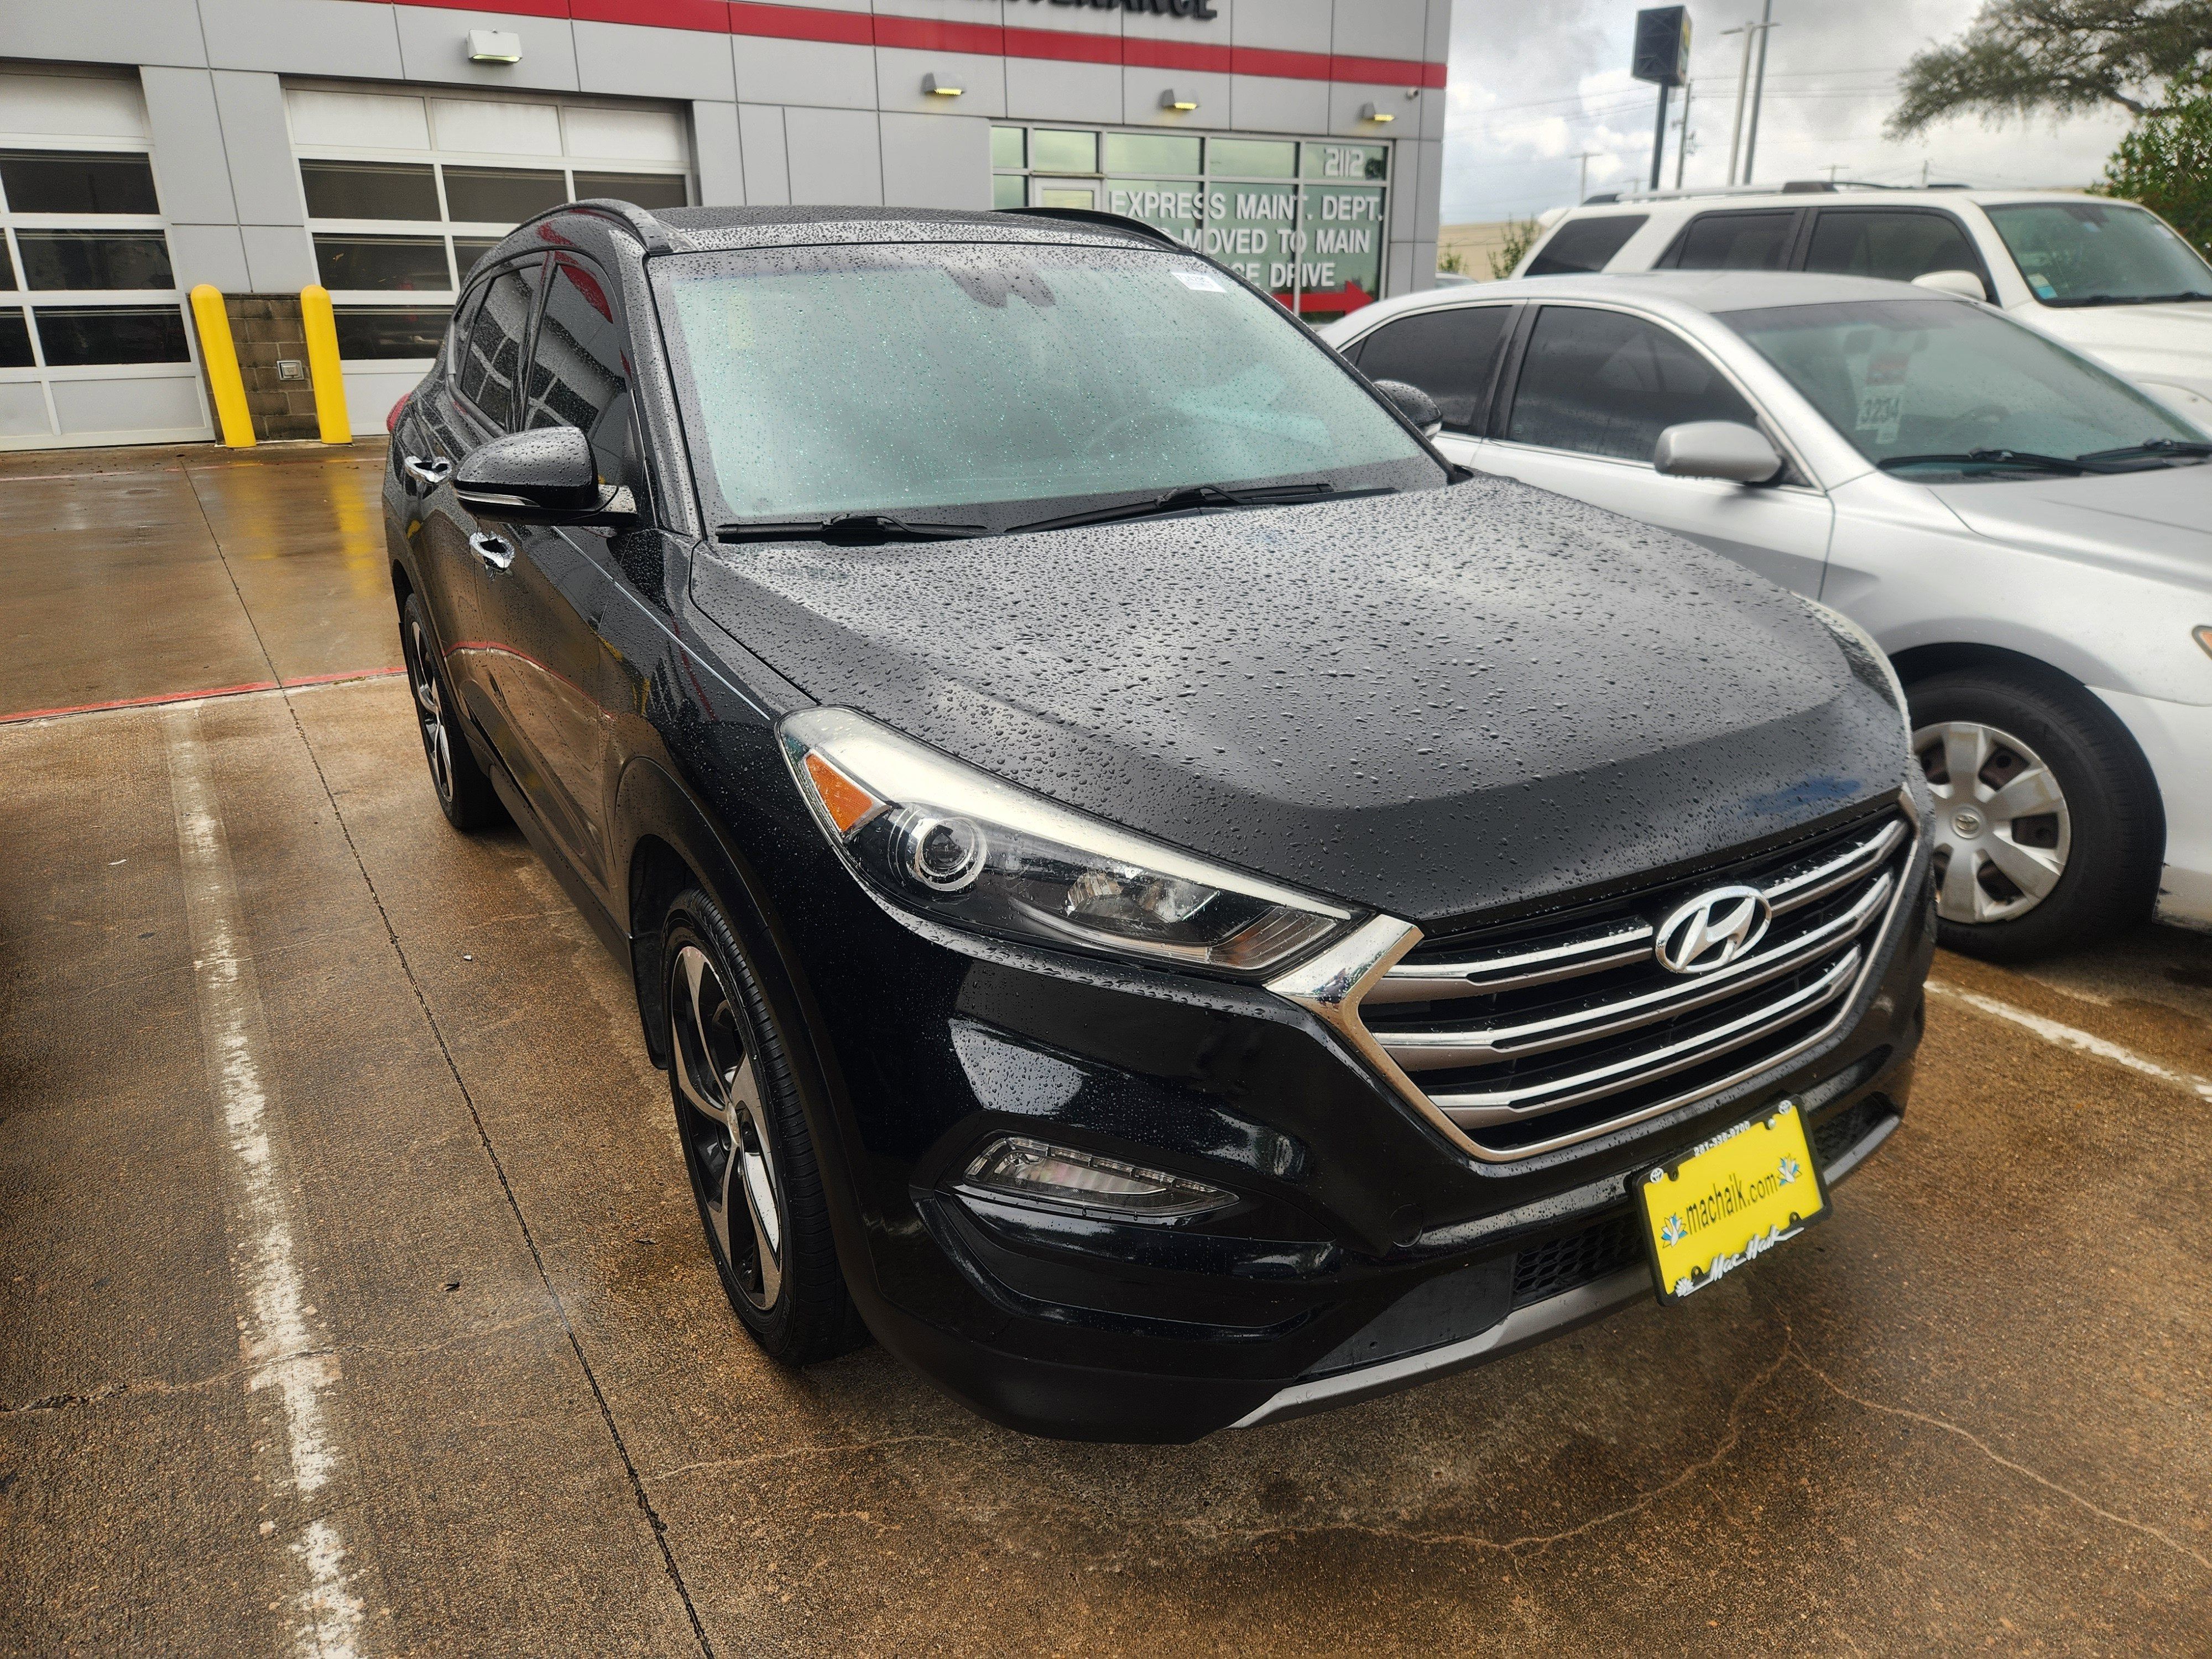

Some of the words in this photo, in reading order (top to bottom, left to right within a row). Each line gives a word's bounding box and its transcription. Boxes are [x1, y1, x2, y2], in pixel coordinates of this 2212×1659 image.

[1324, 148, 1364, 177] 2112
[1110, 190, 1226, 220] EXPRESS
[1322, 195, 1383, 221] DEPT.
[1182, 227, 1268, 255] MOVED
[1276, 228, 1307, 254] TO
[1315, 228, 1371, 254] MAIN
[1686, 1172, 1778, 1235] machaik.com
[1699, 1252, 1746, 1286] Mac
